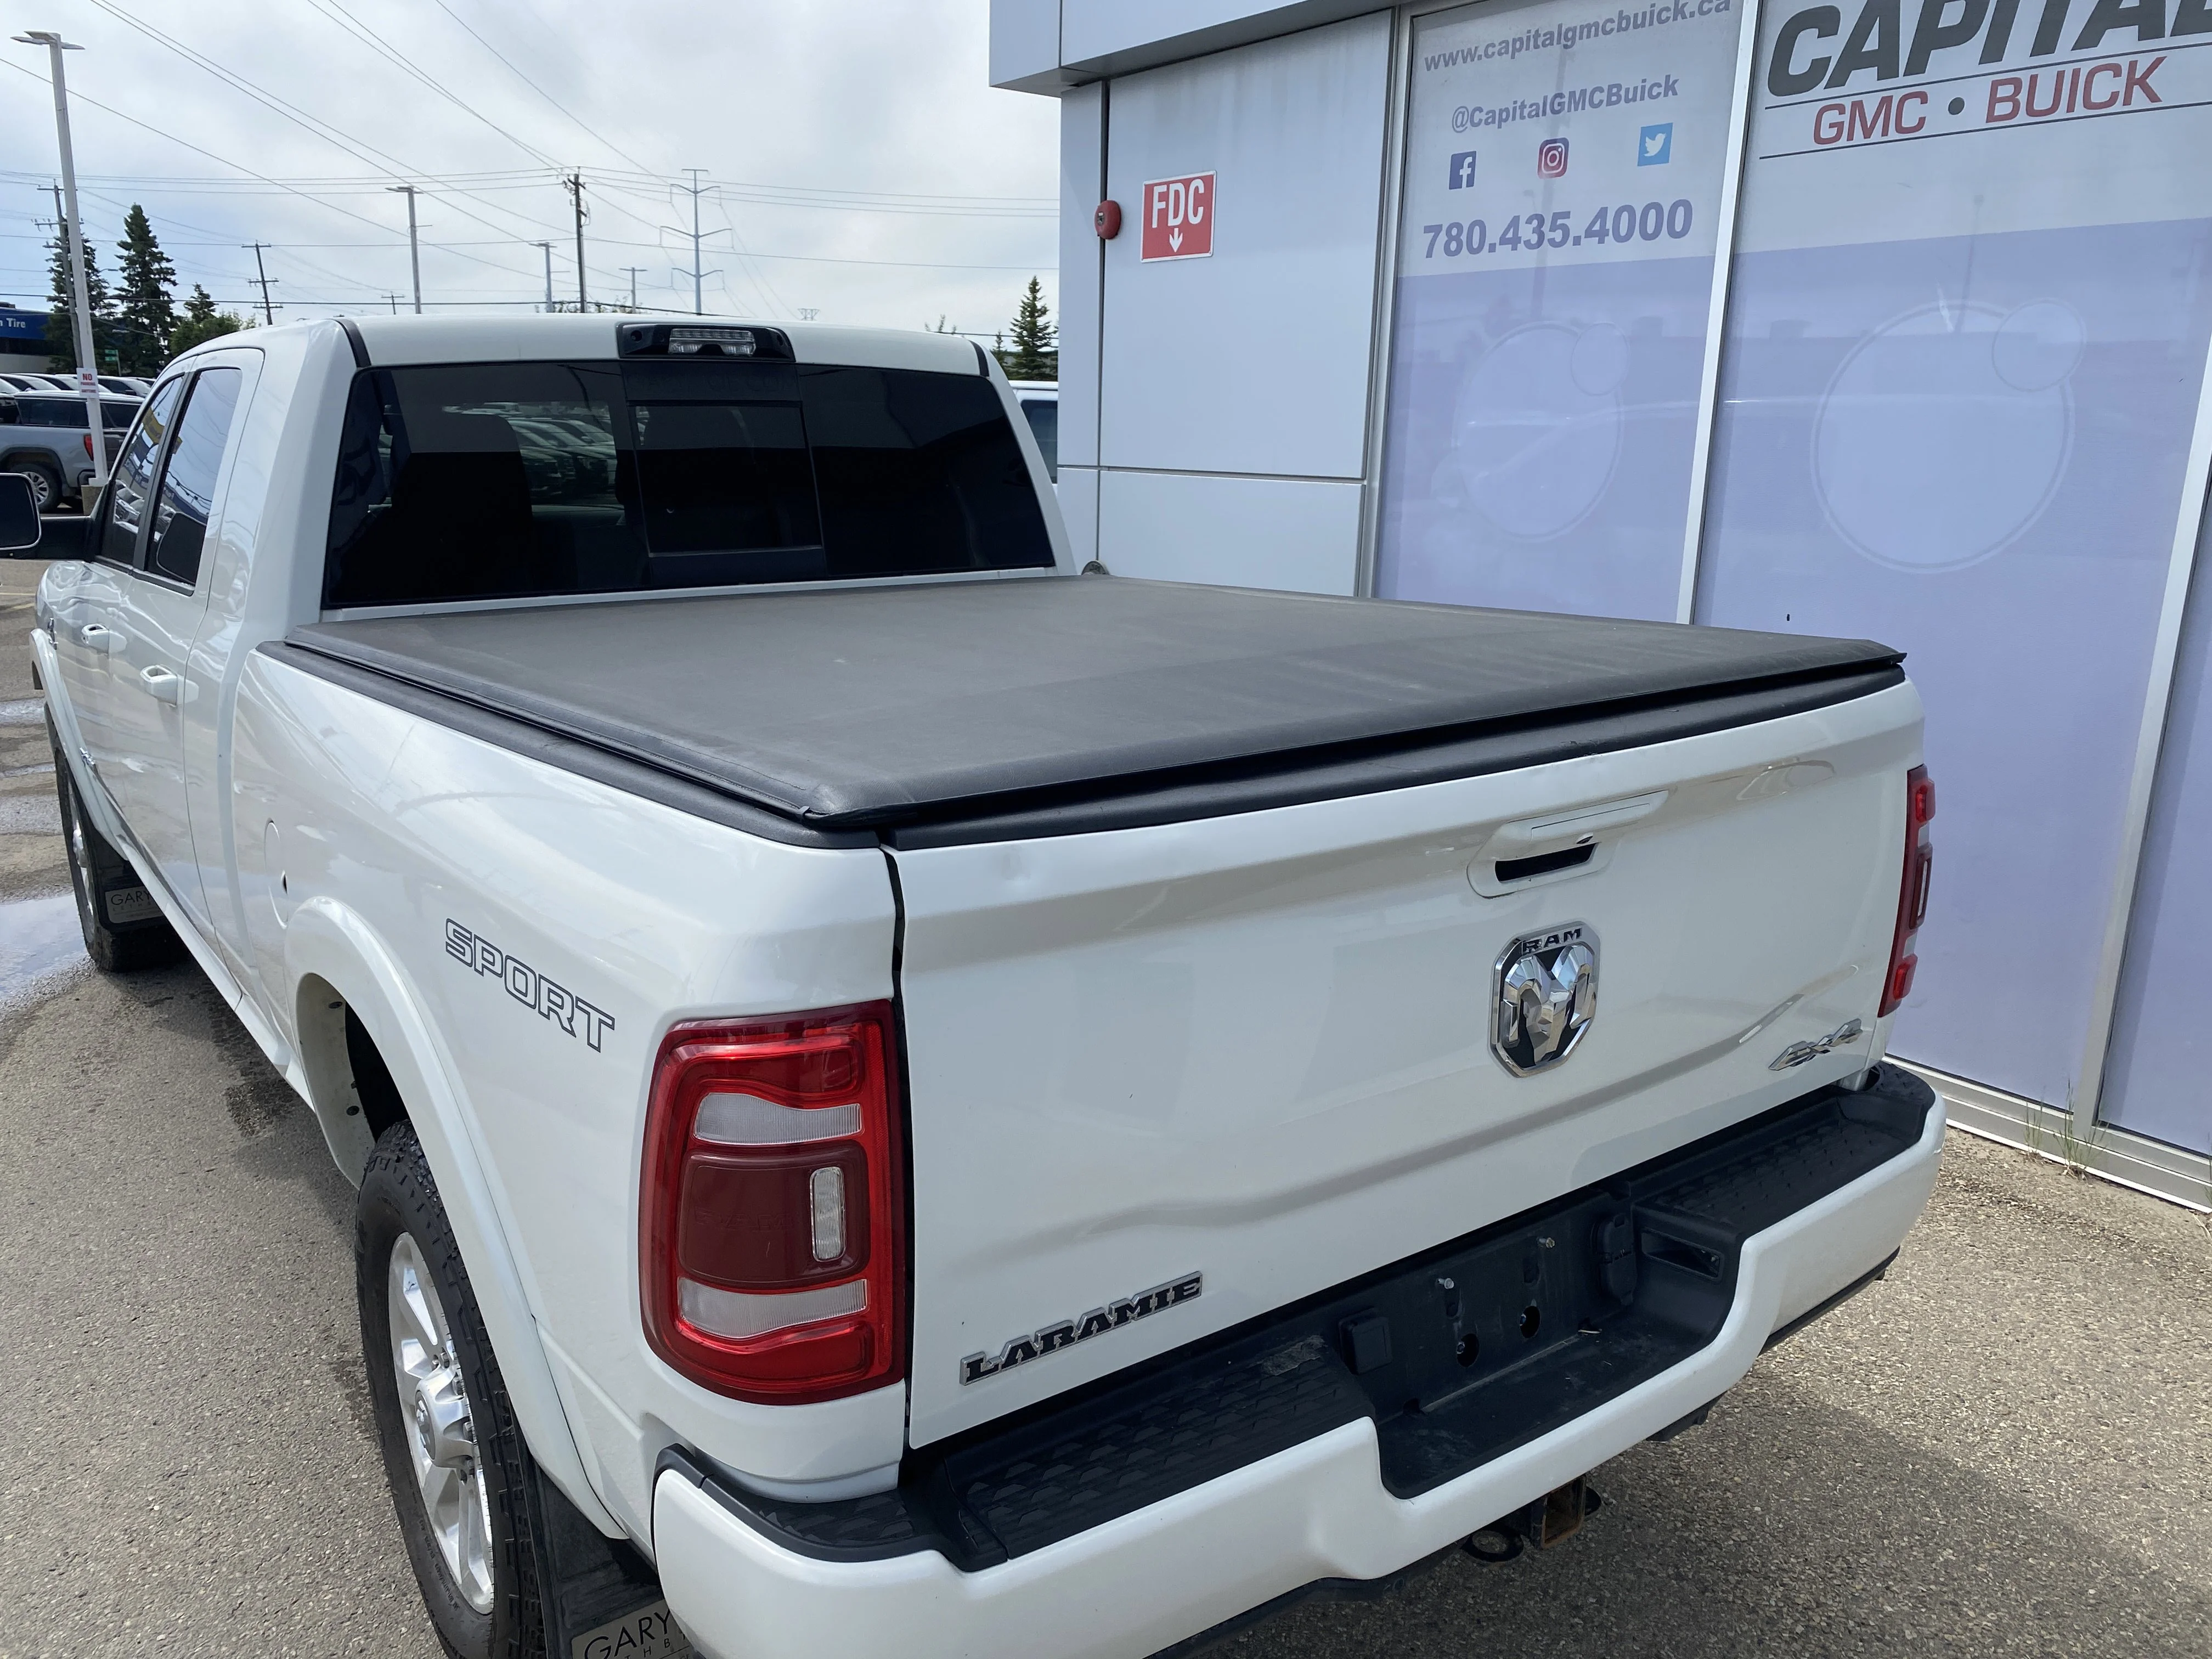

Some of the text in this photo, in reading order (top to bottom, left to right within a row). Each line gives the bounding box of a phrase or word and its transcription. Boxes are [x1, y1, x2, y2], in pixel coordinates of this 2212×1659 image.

[1425, 0, 1730, 71] www.capitalgmcbuick.ca
[1452, 75, 1679, 133] @CapitalGMCBuick
[1813, 57, 2167, 145] GMC BUICK
[1152, 178, 1205, 228] FDC
[1423, 199, 1693, 258] 780.435.4000
[6, 318, 26, 328] Tire
[111, 890, 150, 905] GARY
[1522, 928, 1582, 954] RAM
[445, 918, 615, 1053] SPORT
[960, 1271, 1203, 1386] LARAMIE
[584, 1608, 670, 1659] GARY
